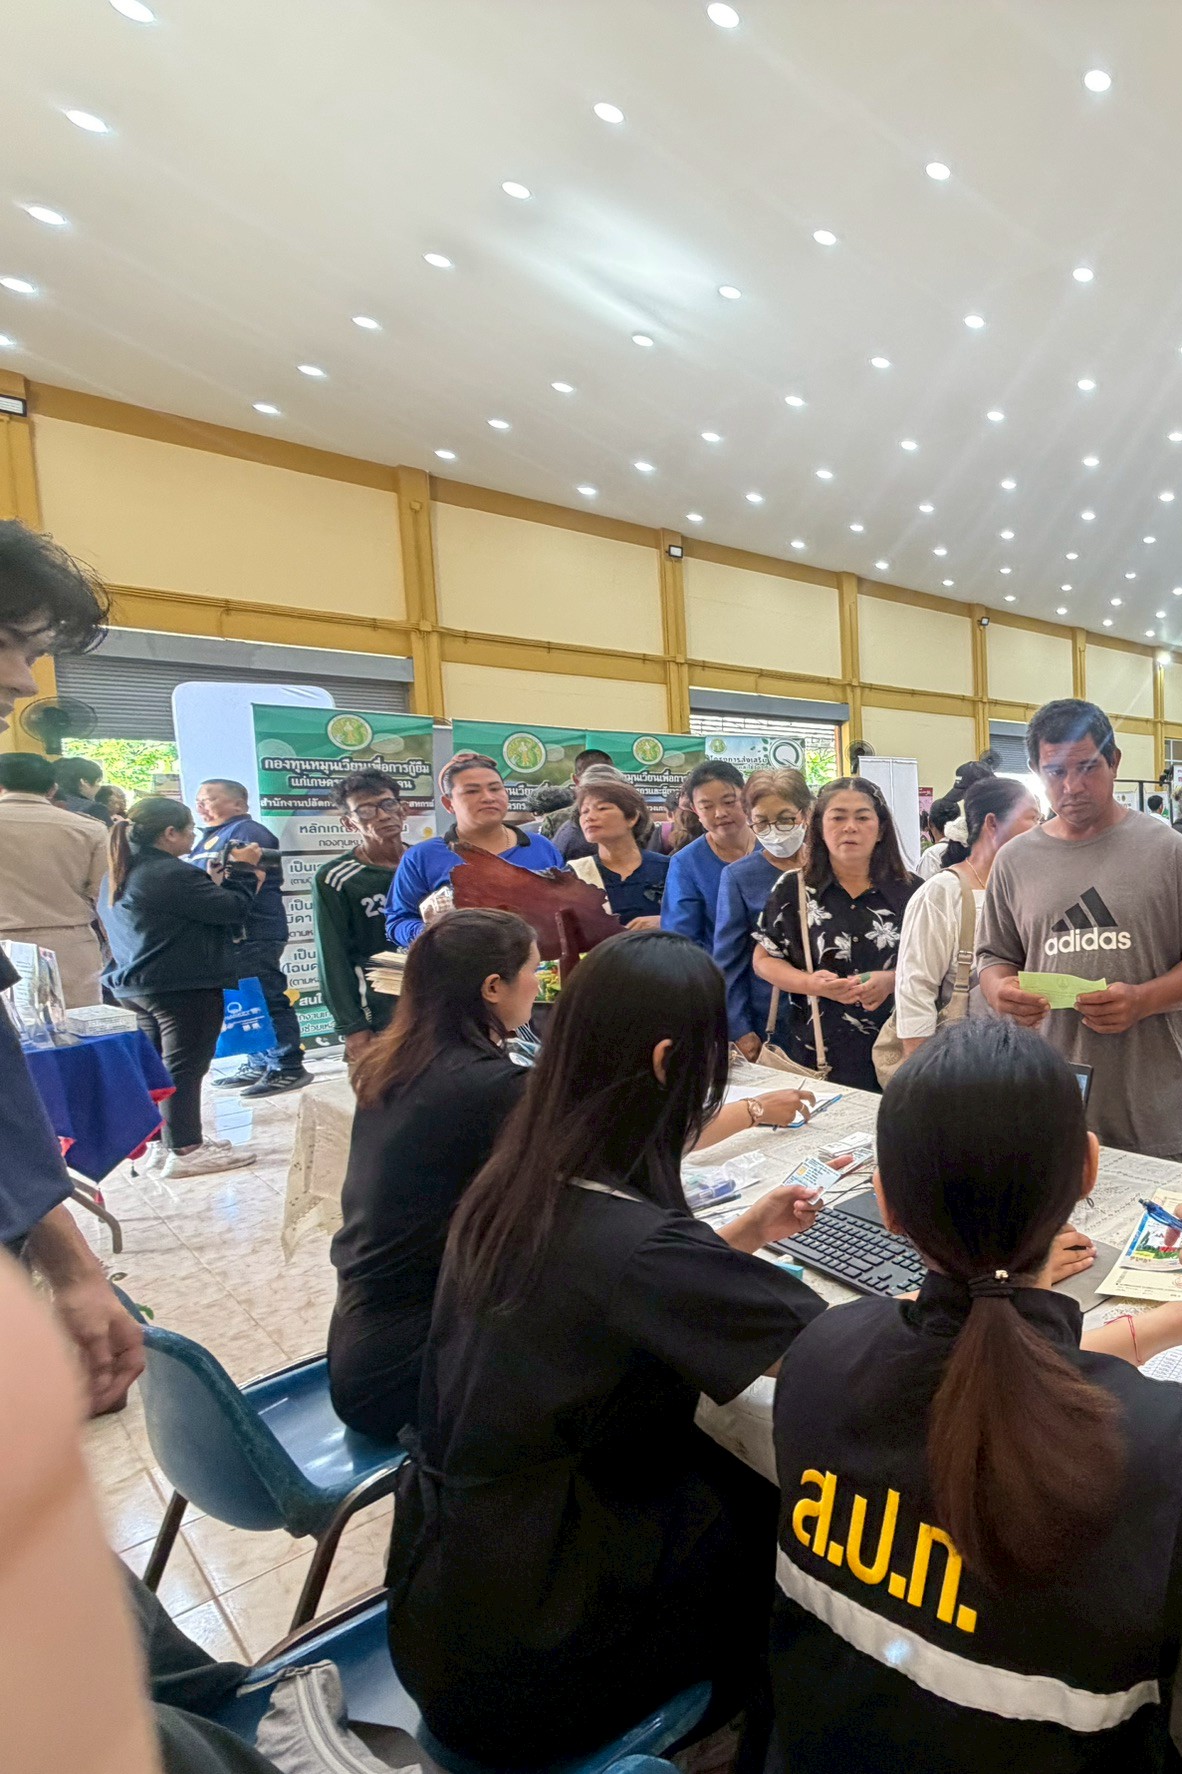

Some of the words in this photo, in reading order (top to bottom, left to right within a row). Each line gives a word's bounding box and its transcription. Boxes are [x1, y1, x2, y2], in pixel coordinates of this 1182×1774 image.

[361, 894, 388, 918] 23
[1044, 927, 1132, 956] adidas
[792, 1468, 978, 1633] ส.ป.ก.
